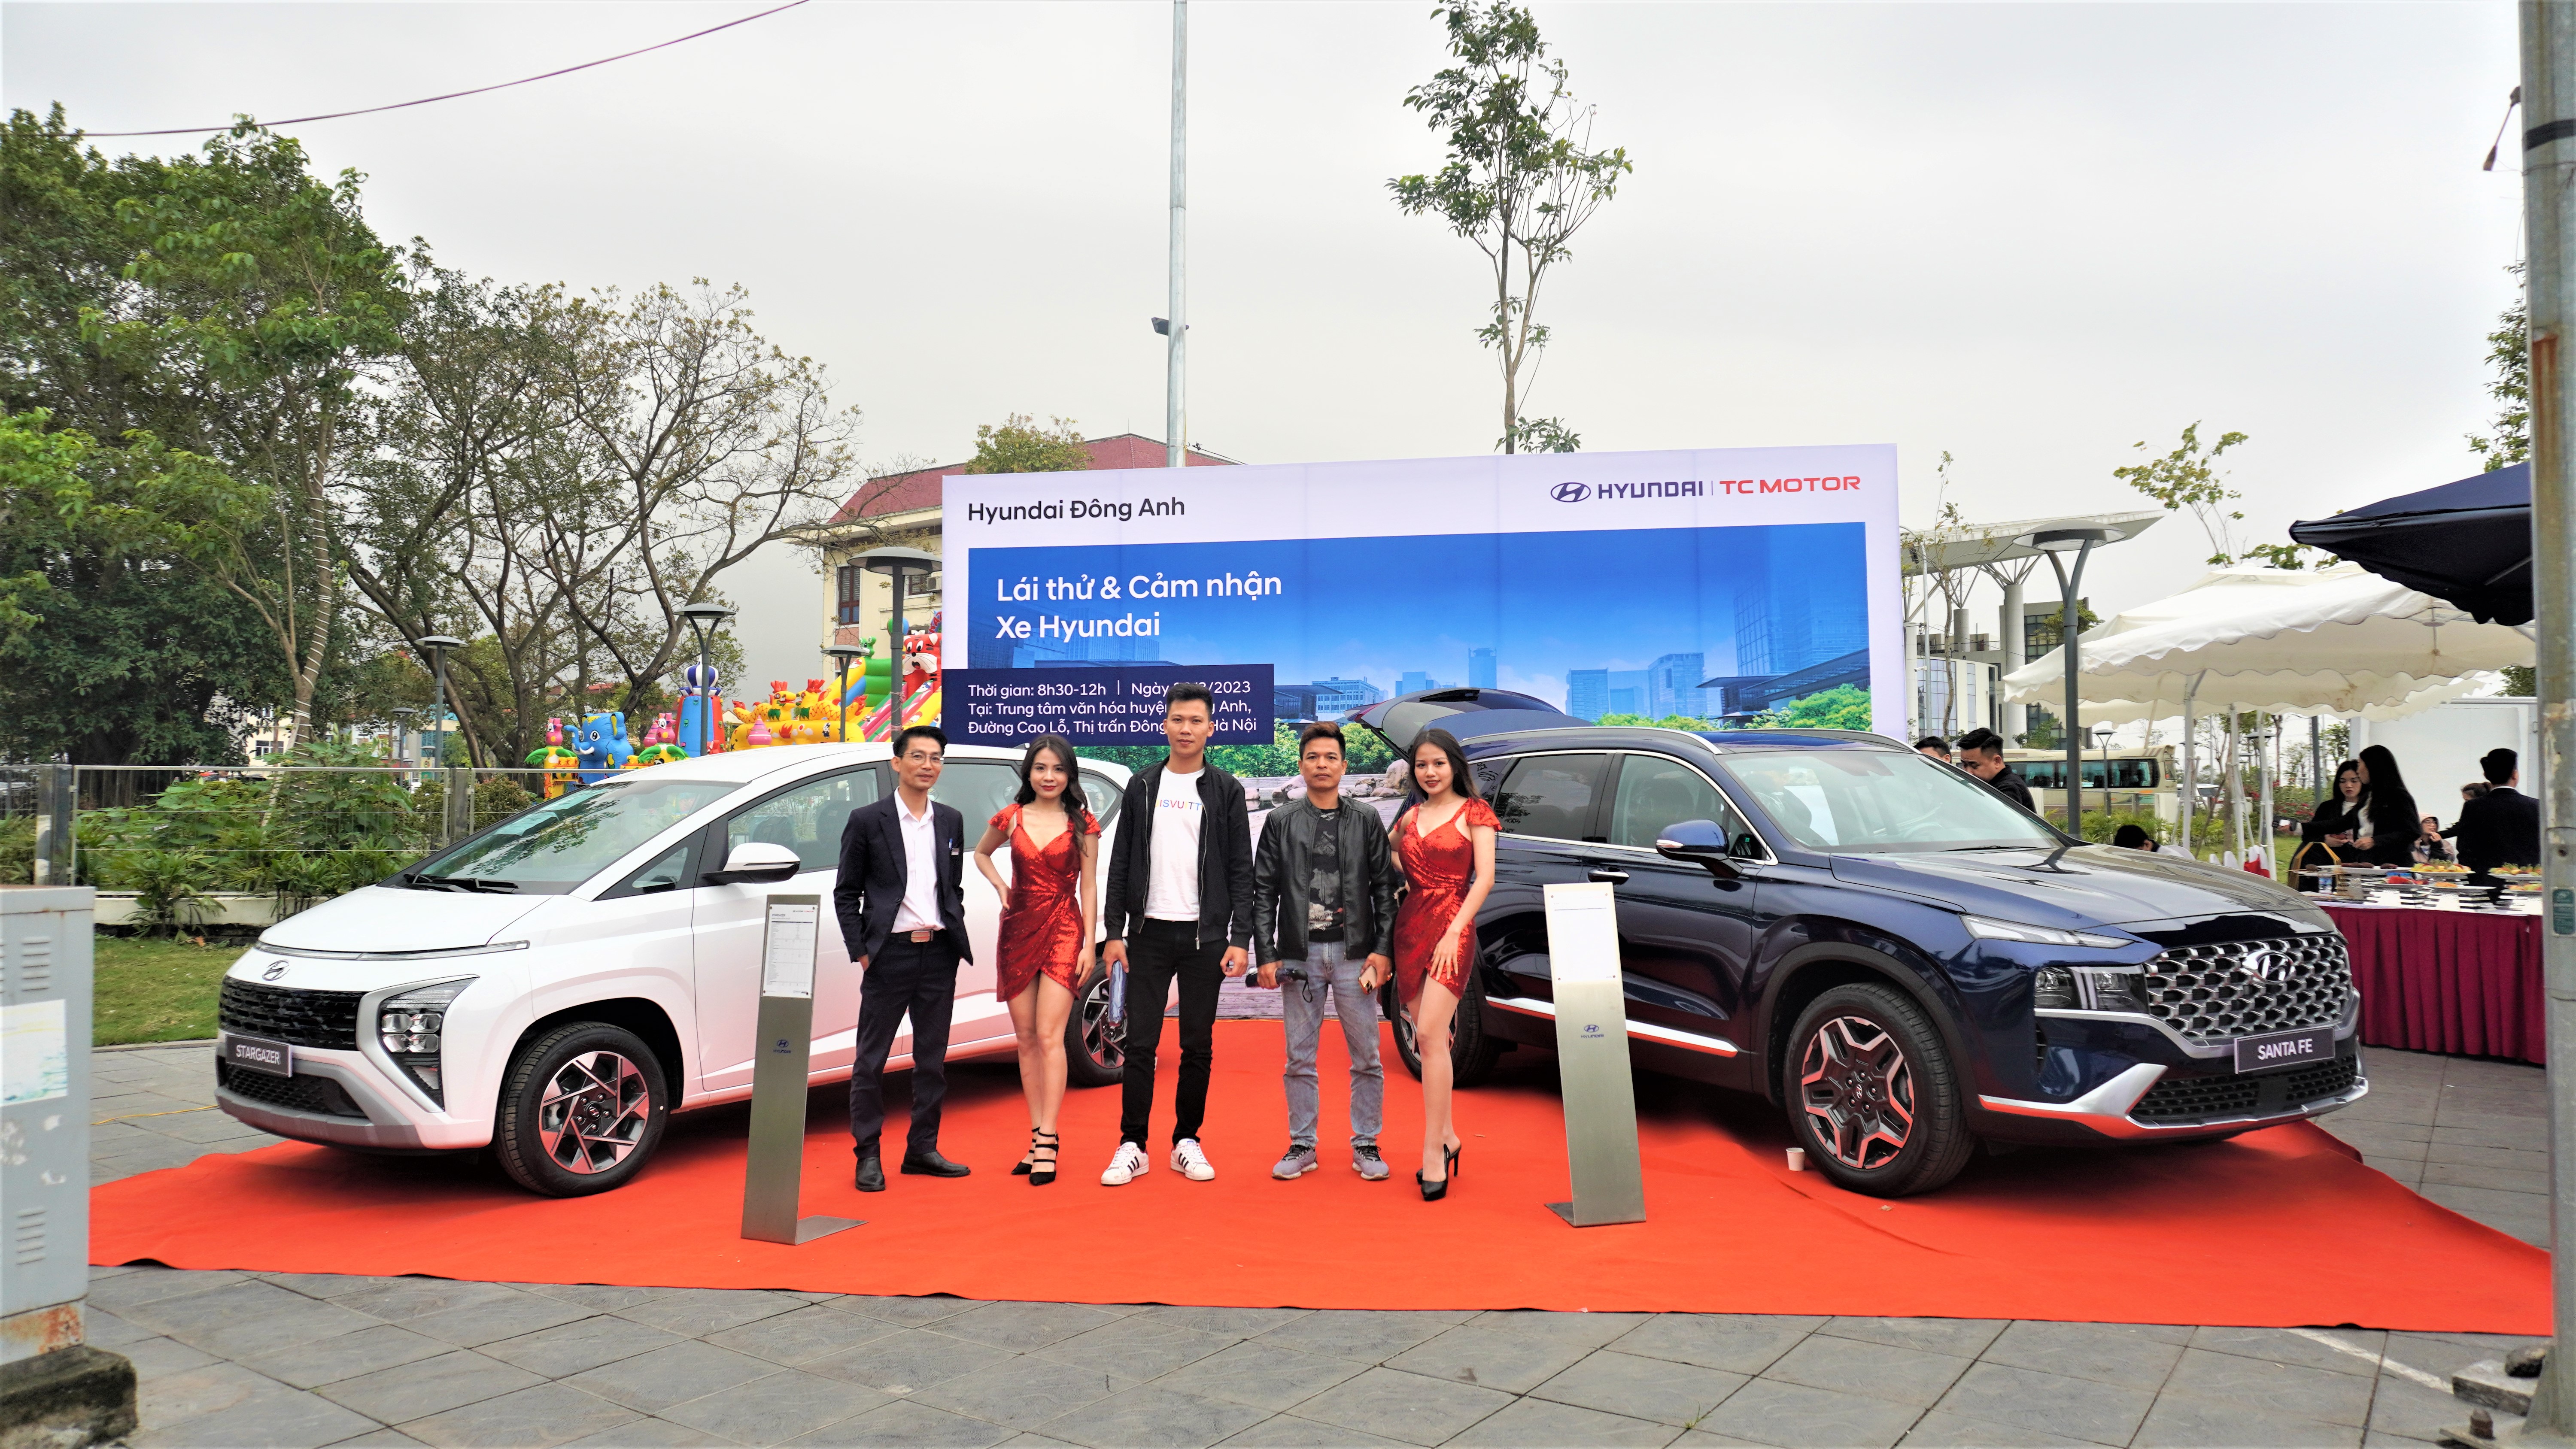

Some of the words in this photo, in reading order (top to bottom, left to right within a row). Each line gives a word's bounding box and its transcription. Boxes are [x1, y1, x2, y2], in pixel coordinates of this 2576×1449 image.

[1598, 481, 1703, 499] HYUNDAI
[1719, 480, 1754, 494] TC
[1760, 476, 1861, 493] MOTOR
[969, 500, 1063, 525] Hyundai
[1069, 498, 1132, 521] Đông
[1138, 497, 1185, 516] Anh
[998, 576, 1038, 601] Lái
[1045, 574, 1095, 600] thử
[1100, 576, 1121, 600] &
[1128, 572, 1198, 598] Cảm
[1206, 570, 1281, 601] nhận
[995, 615, 1031, 639] Xe
[1039, 611, 1160, 643] Hyundai
[968, 684, 997, 697] Thời
[1000, 684, 1034, 699] gian:
[1037, 683, 1106, 696] 8h30-12h
[1132, 682, 1169, 697] Ngày
[1173, 681, 1251, 694] /2023
[968, 703, 992, 717] Tại:
[995, 703, 1034, 718] Trung
[1037, 702, 1066, 714] tâm
[1069, 702, 1095, 714] văn
[1099, 701, 1126, 714] hóa
[1130, 701, 1167, 716] huyệ
[1219, 700, 1251, 714] Anh,
[968, 721, 1013, 736] Đường
[1017, 721, 1046, 733] Cao
[1049, 718, 1069, 735] Lỗ,
[1073, 720, 1094, 735] Thị
[1097, 718, 1126, 733] trấn
[1130, 719, 1166, 735] Đông
[1233, 718, 1256, 733] Nội
[236, 1044, 281, 1065] STARGAZER
[2257, 1041, 2297, 1060] SANTA
[2298, 1038, 2313, 1054] FE
